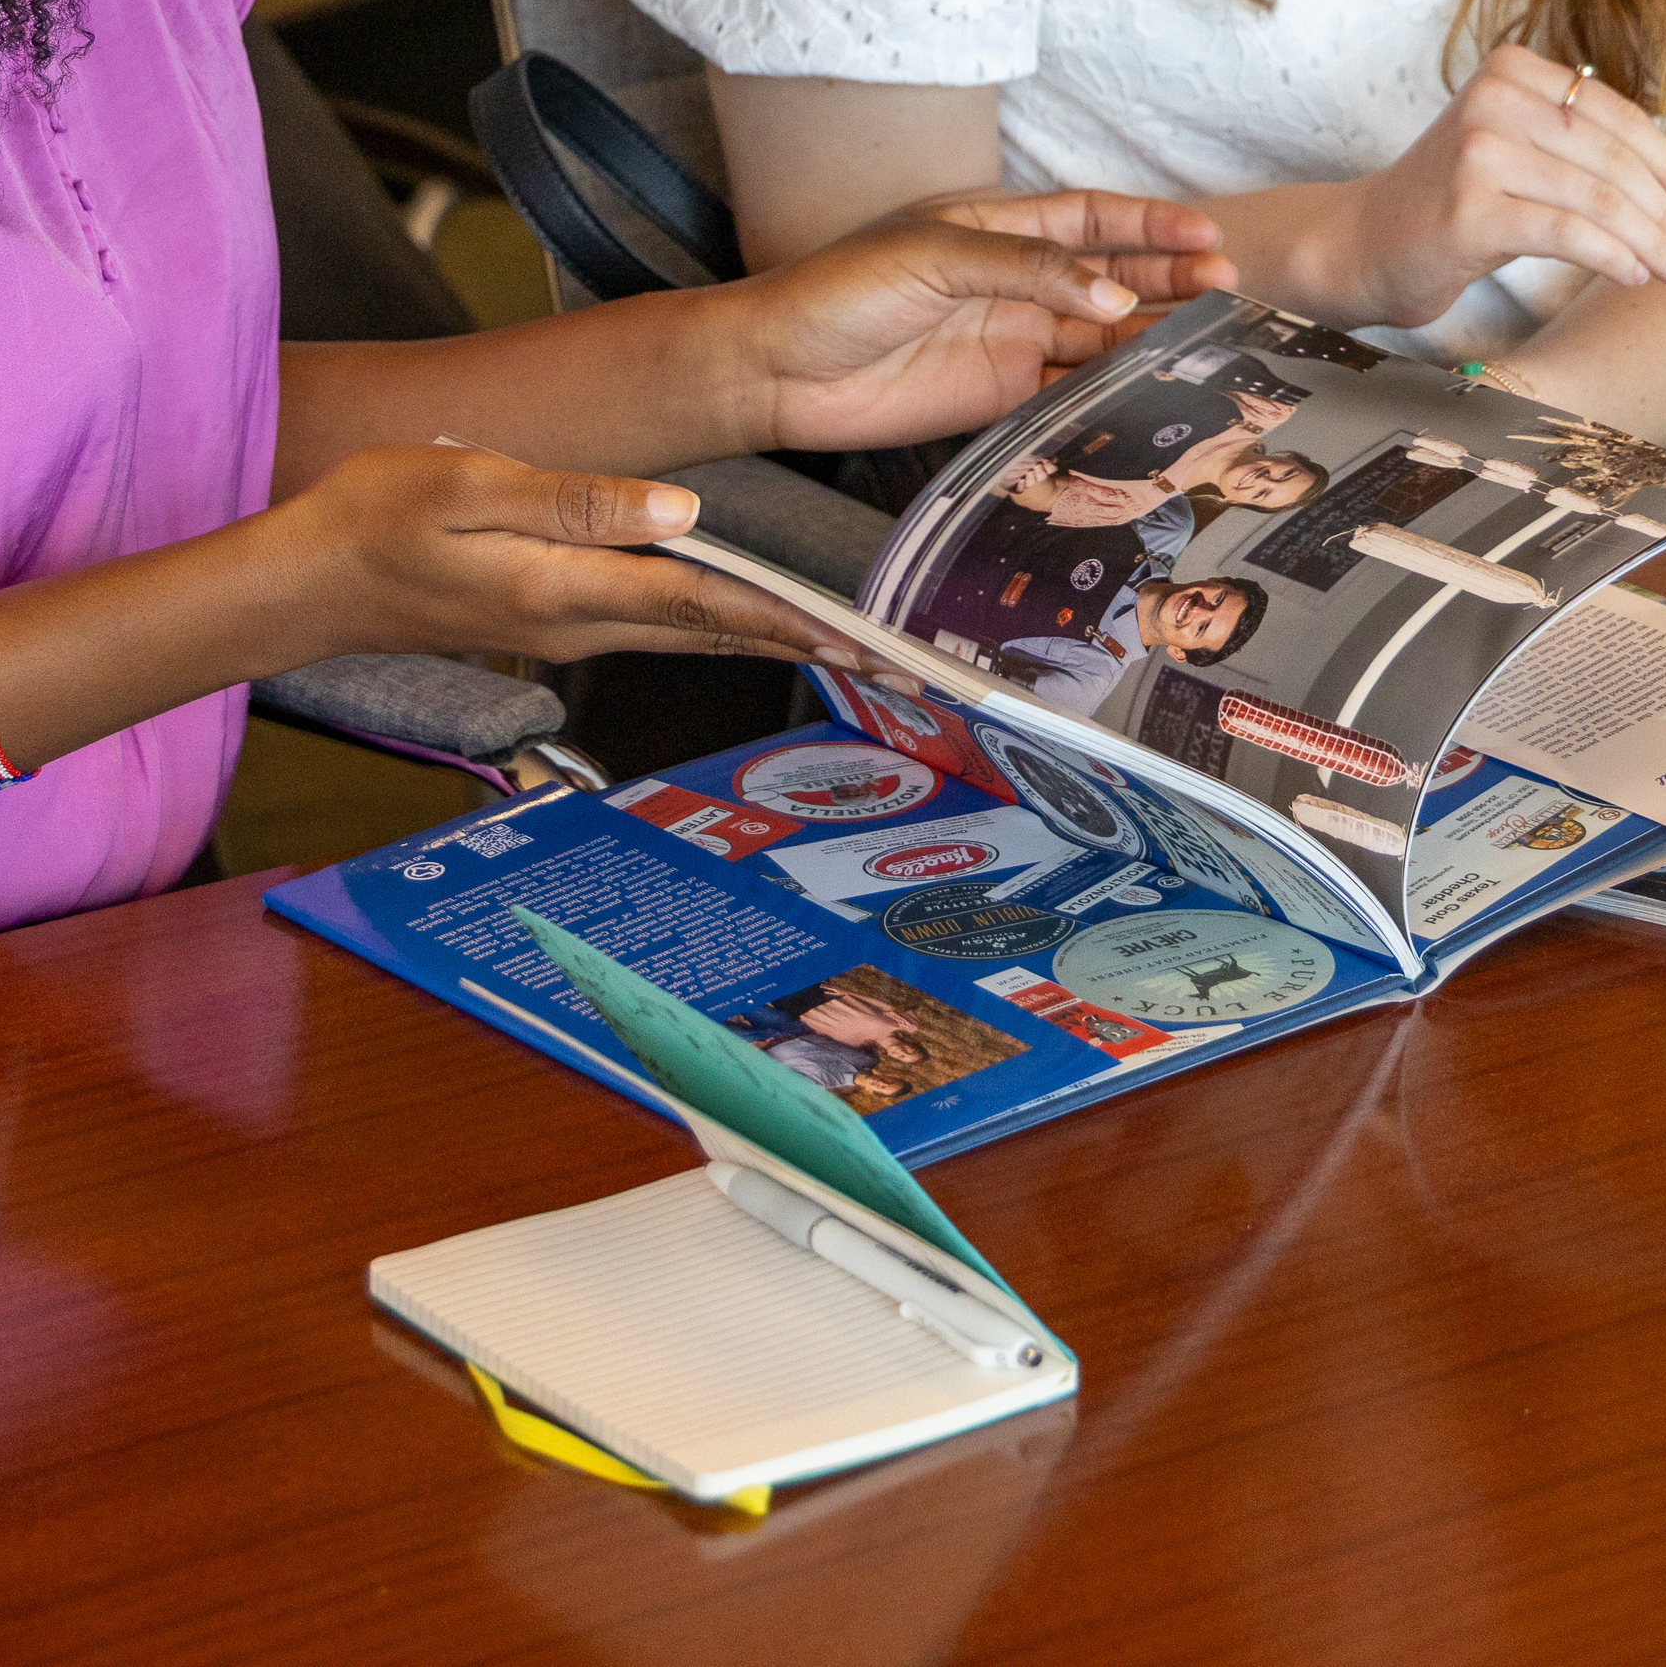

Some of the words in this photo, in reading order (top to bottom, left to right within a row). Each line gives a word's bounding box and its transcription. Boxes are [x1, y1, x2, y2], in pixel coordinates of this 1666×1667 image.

[800, 773, 874, 791] CHEESE
[790, 784, 923, 818] MOZZARELLA
[669, 808, 727, 835] LATTERI
[584, 834, 610, 846] Otto's
[553, 845, 585, 859] Cheese
[572, 838, 619, 860] adventures
[623, 848, 639, 856] the
[530, 857, 555, 868] Shop
[588, 851, 613, 862] Keep
[597, 854, 623, 866] spark
[885, 846, 974, 876] Knolle
[545, 858, 571, 870] along
[500, 871, 521, 881] New
[530, 868, 546, 876] the
[543, 871, 564, 880] with
[561, 872, 580, 882] new
[503, 875, 531, 887] Texas
[519, 881, 538, 890] Bob
[530, 880, 560, 893] dream
[652, 879, 670, 887] But
[1063, 862, 1150, 912] MOULTONZOLA
[471, 886, 504, 900] Cheese
[494, 890, 513, 900] and
[624, 887, 649, 899] when
[1420, 874, 1479, 909] Cheddar
[1456, 879, 1501, 903] Texas
[425, 897, 457, 911] Texas!
[457, 900, 490, 915] Rachel
[587, 897, 622, 914] patrons
[426, 908, 445, 919] and
[555, 913, 586, 926] began
[723, 905, 755, 922] around
[1423, 904, 1460, 924] Gold
[405, 917, 427, 927] visit
[415, 914, 453, 931] Pineda's
[708, 919, 724, 927] the
[899, 918, 963, 941] DOWN
[500, 941, 516, 949] for
[698, 941, 736, 959] Located
[808, 941, 827, 950] The
[1113, 929, 1198, 958] CHÈVRE
[1188, 933, 1269, 958] FARMSTEAD
[472, 948, 496, 960] more
[780, 948, 808, 961] vision
[1146, 951, 1183, 968] GOAT
[671, 961, 687, 969] the
[765, 960, 781, 968] for
[645, 967, 672, 980] heart
[737, 966, 764, 979] Otto's
[1087, 961, 1144, 983] CHEESE
[704, 978, 737, 993] Cheese
[1263, 957, 1316, 1002] PURE
[679, 990, 704, 1002] Shop
[568, 1000, 589, 1011] Hill
[1131, 999, 1249, 1017] LUCK
